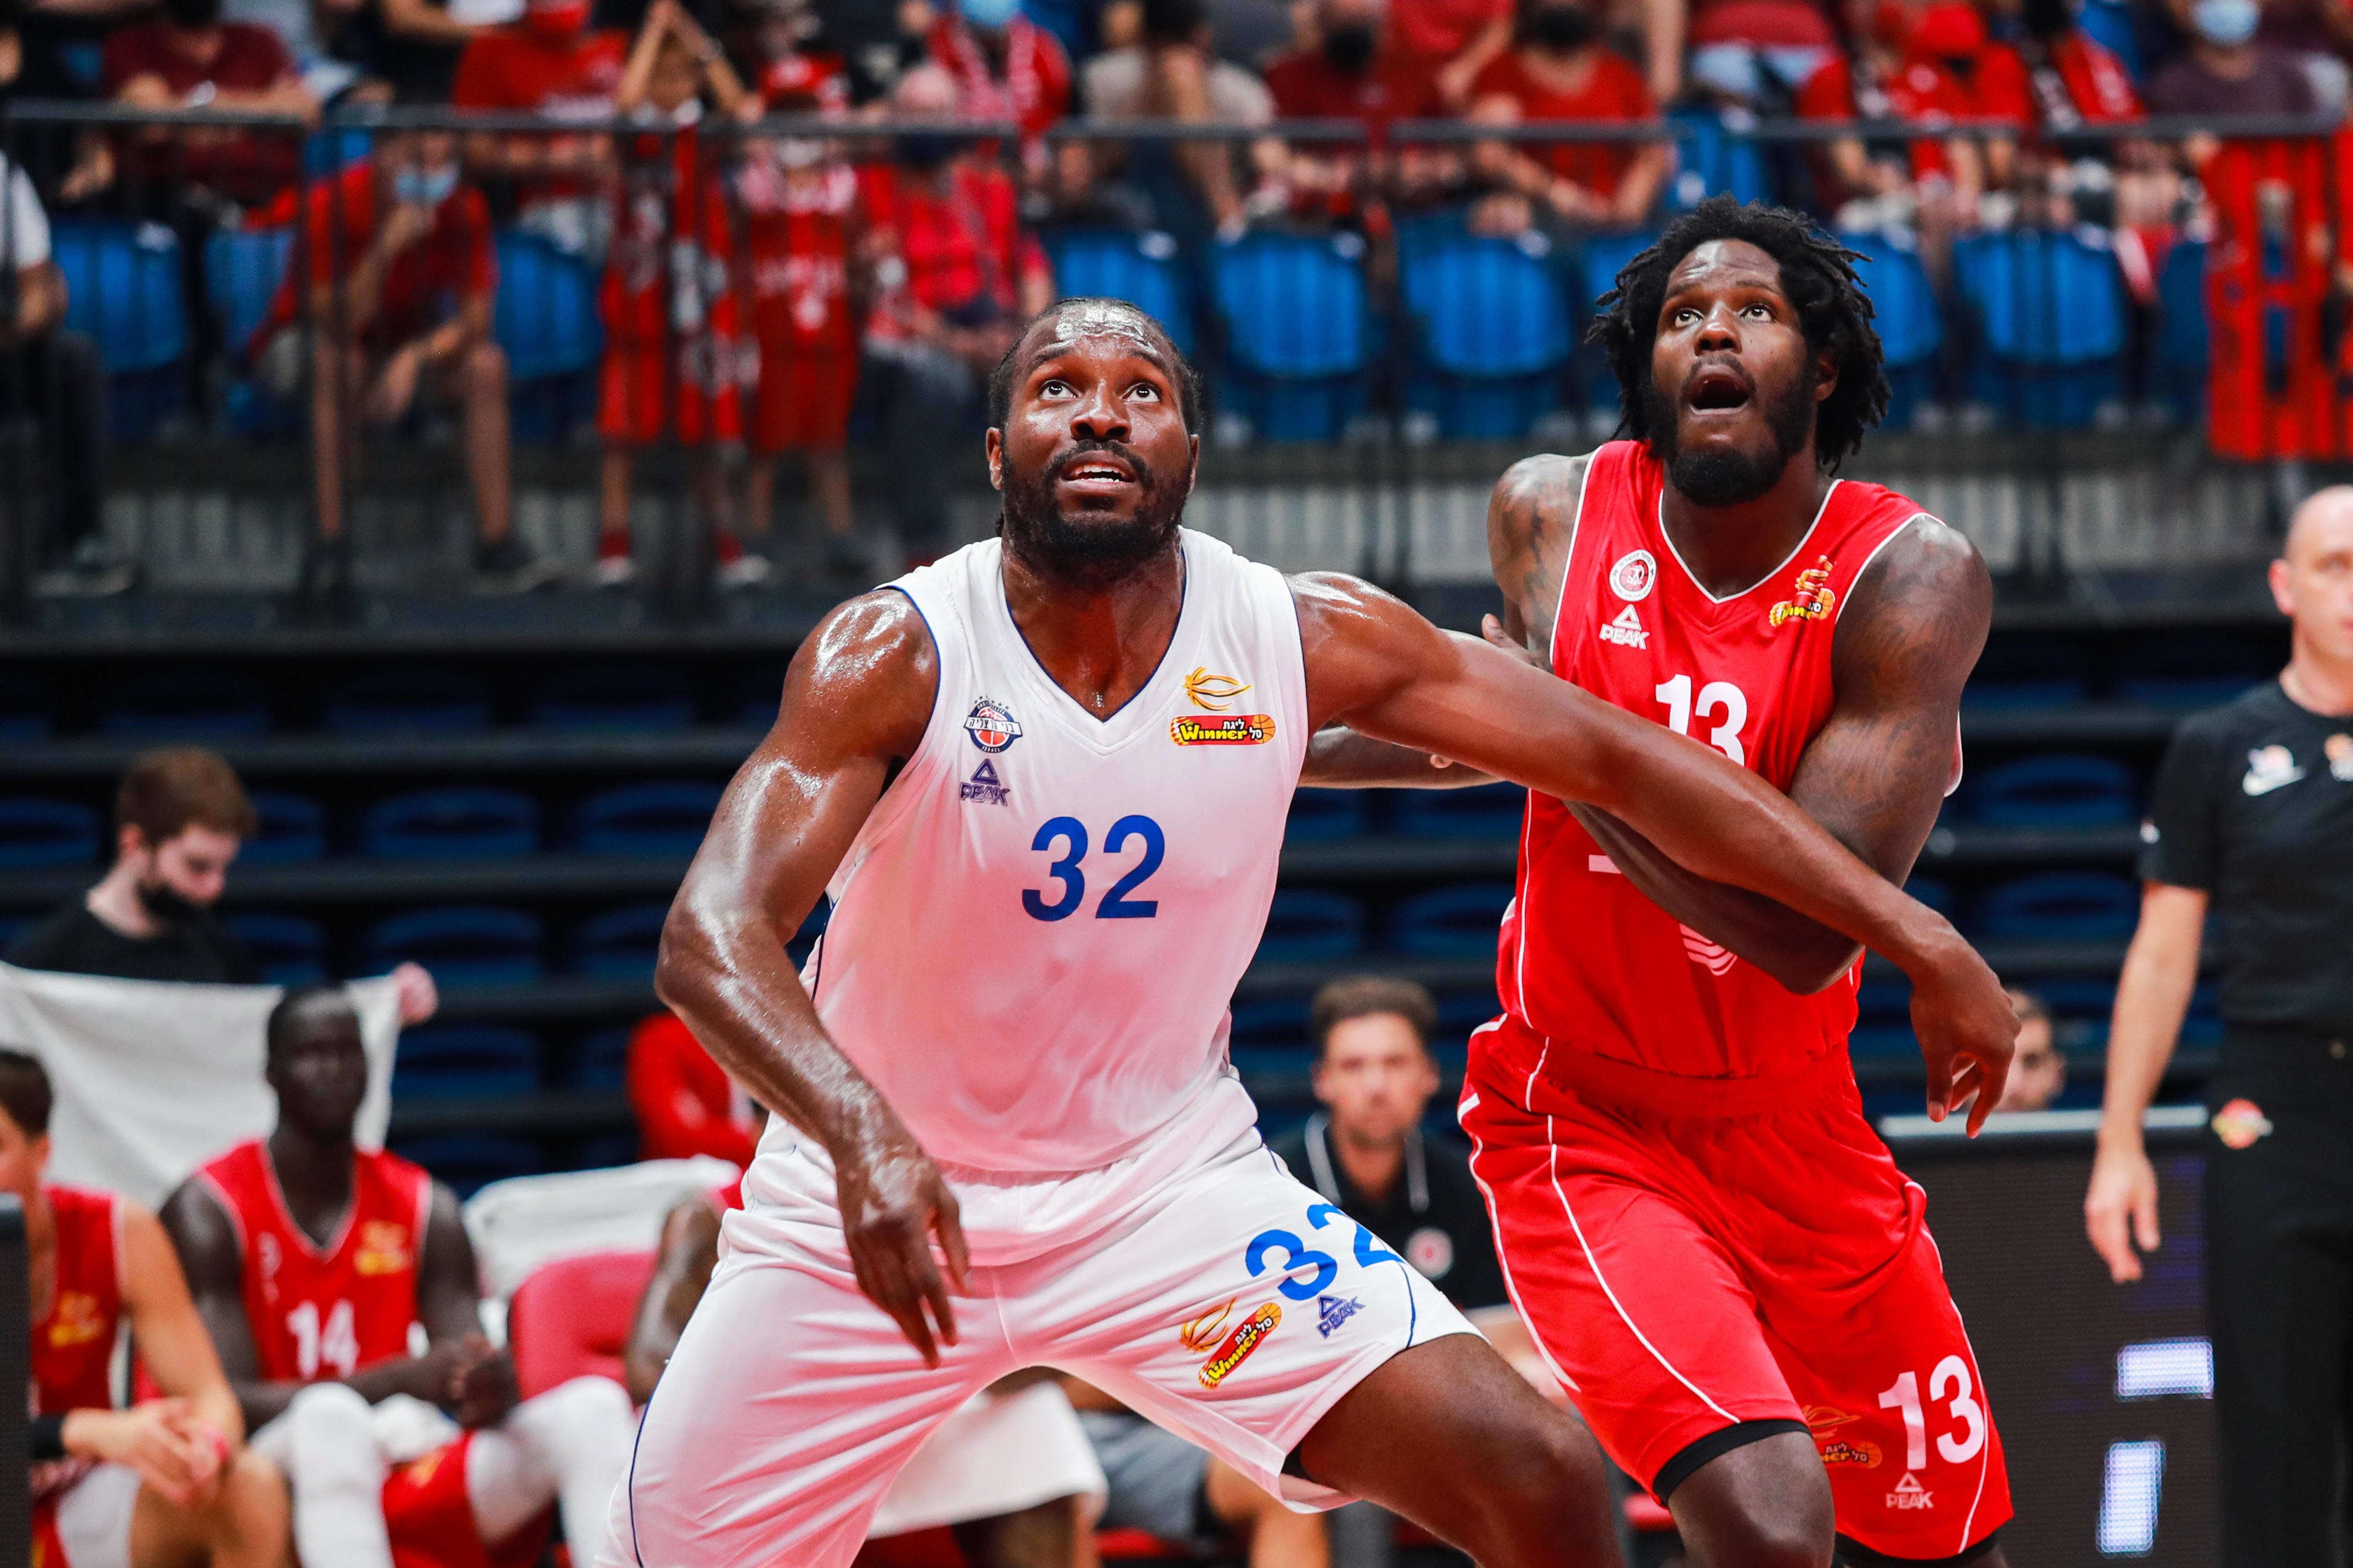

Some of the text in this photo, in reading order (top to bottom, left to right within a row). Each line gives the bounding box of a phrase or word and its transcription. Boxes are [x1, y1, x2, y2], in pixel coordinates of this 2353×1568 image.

[1599, 623, 1650, 650] PEAK
[1179, 724, 1247, 740] Winner
[1222, 718, 1245, 730] ליגת
[1248, 726, 1262, 739] סל
[1655, 674, 1748, 767] 13
[960, 782, 1010, 806] PEAK
[1022, 815, 1165, 922] 32
[1245, 1203, 1407, 1300] 32
[1316, 1296, 1366, 1339] PEAK
[286, 1299, 360, 1380] 14
[1208, 1328, 1258, 1379] Winner
[1878, 1355, 1984, 1470] 13
[1885, 1491, 1935, 1510] PEAK
